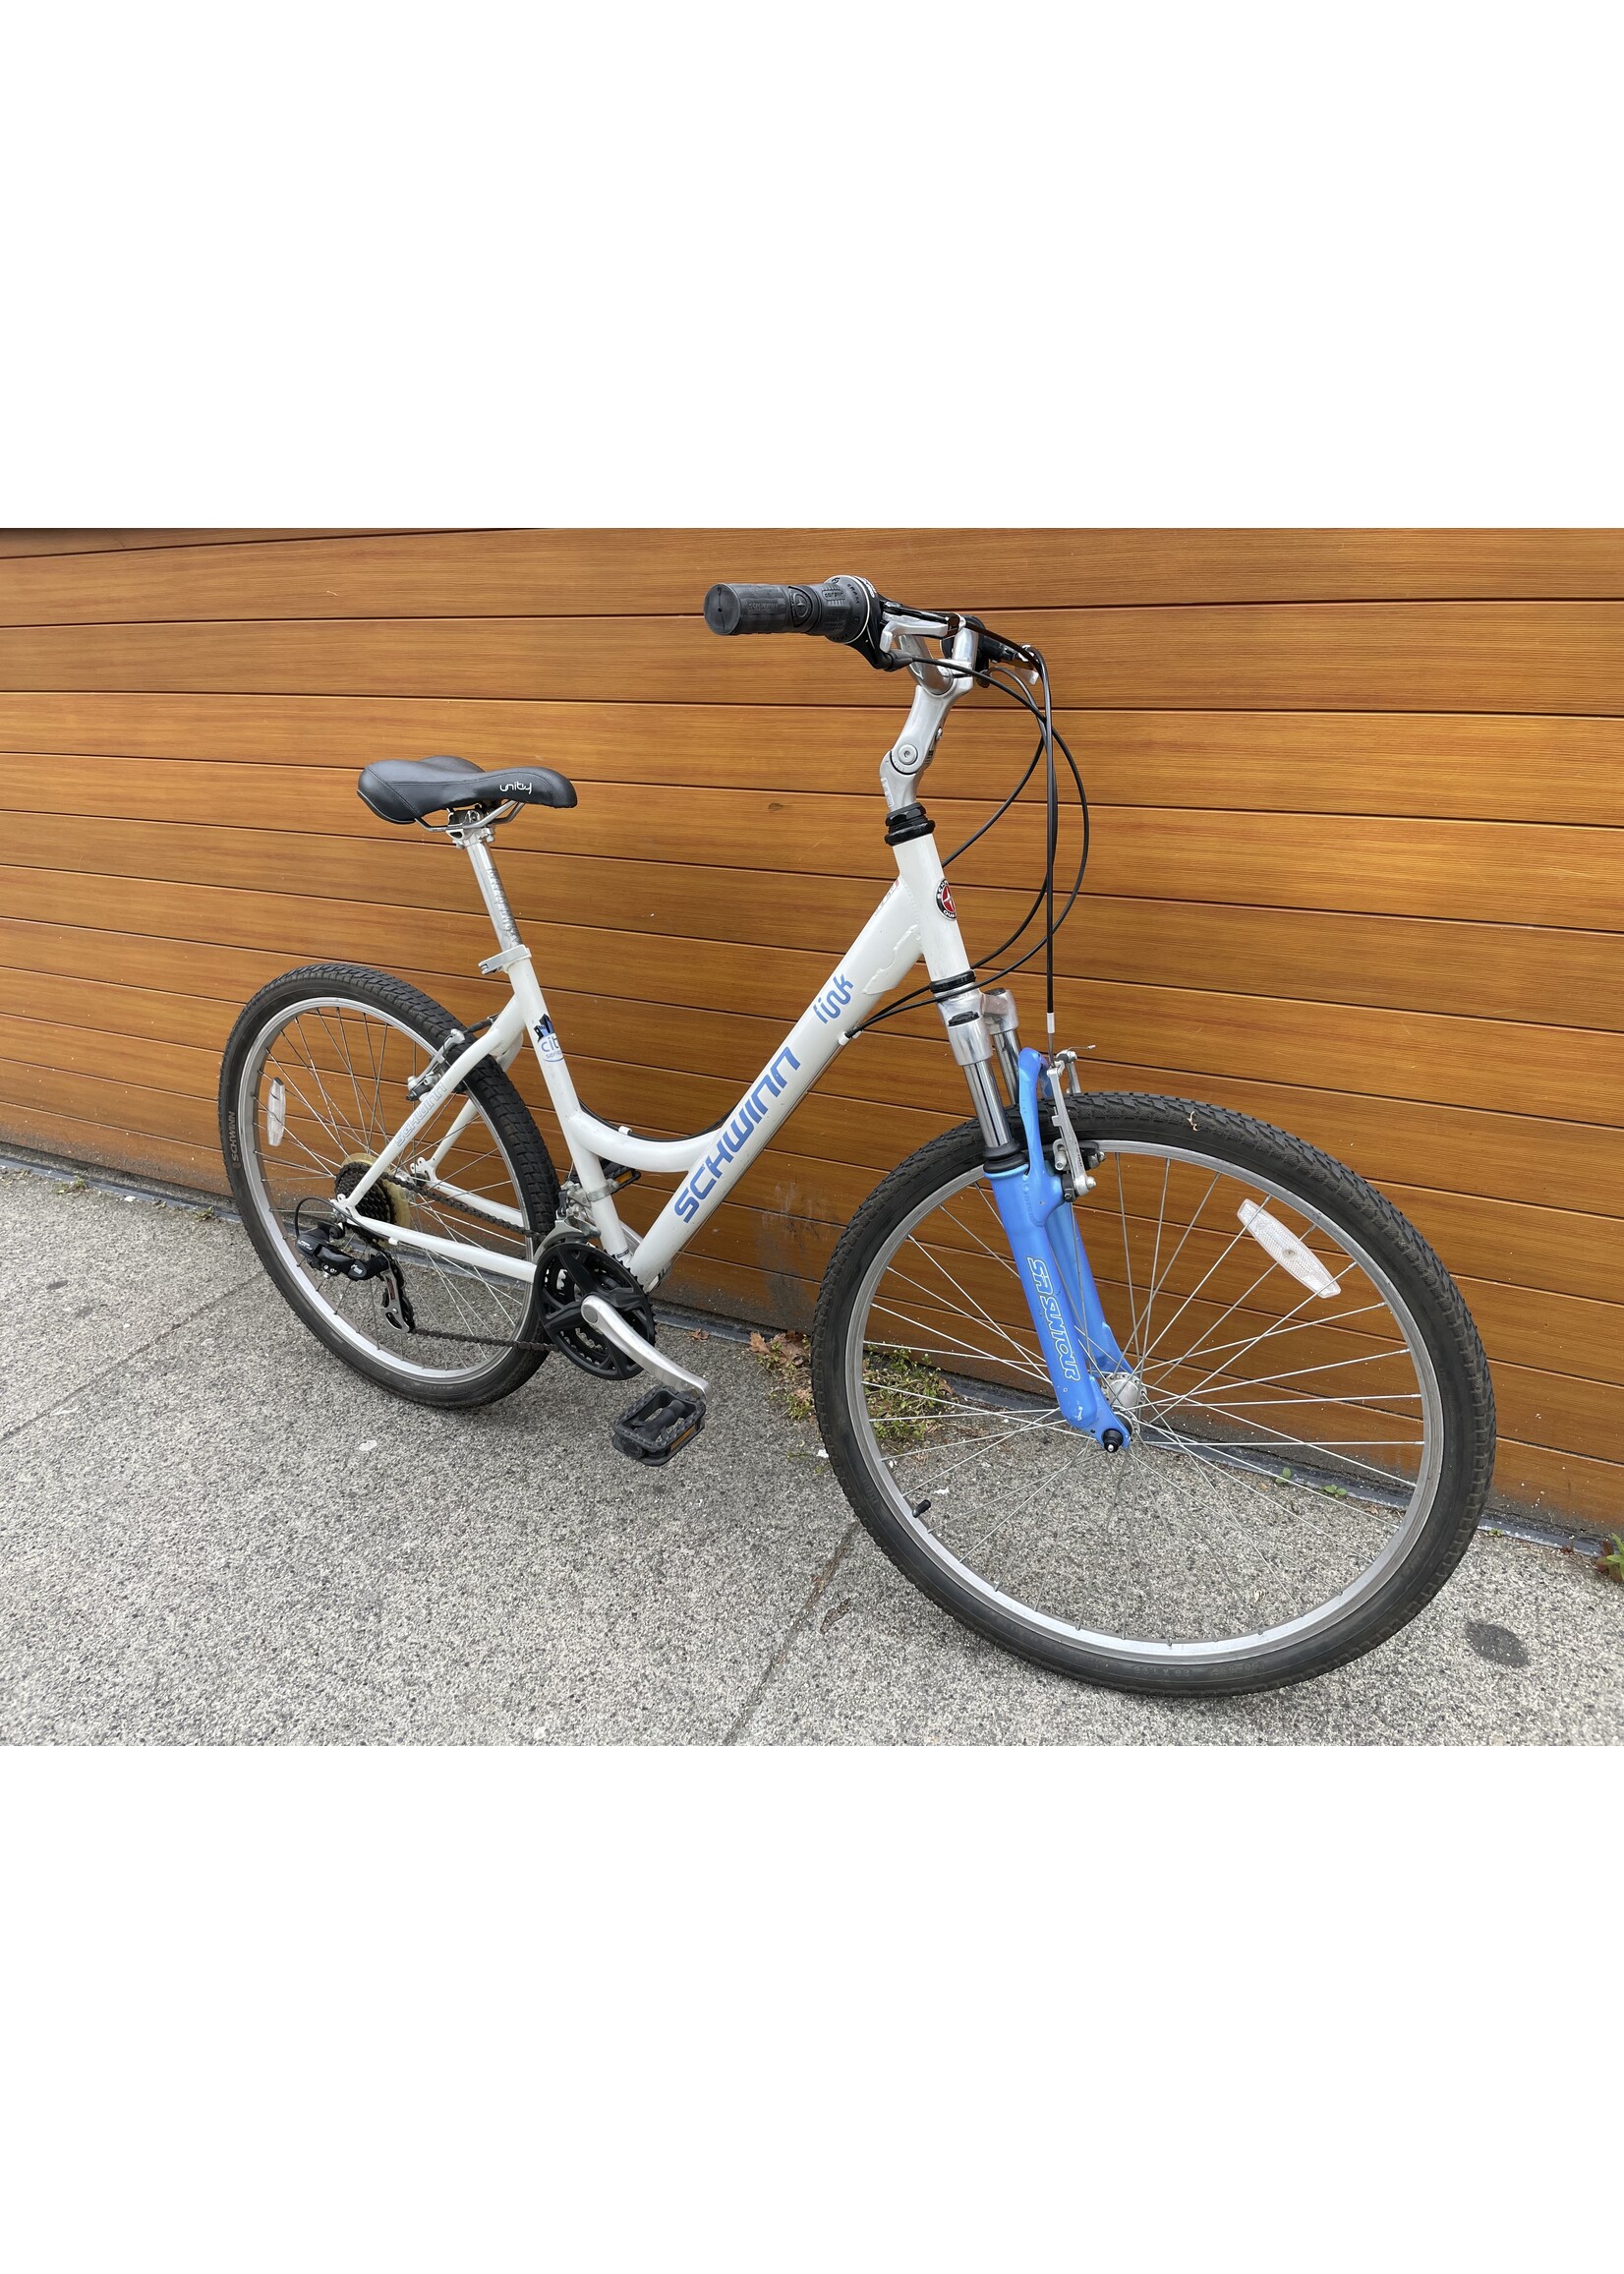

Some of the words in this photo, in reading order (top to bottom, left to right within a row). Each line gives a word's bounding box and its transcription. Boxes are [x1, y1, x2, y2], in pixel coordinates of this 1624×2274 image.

[499, 781, 533, 794] unity
[813, 973, 853, 1024] link
[541, 1036, 559, 1053] cit
[228, 1111, 239, 1162] SCHWINN
[674, 1046, 801, 1224] SCHWINN
[1027, 1256, 1053, 1295] SR
[1040, 1296, 1080, 1381] SUNTOUR
